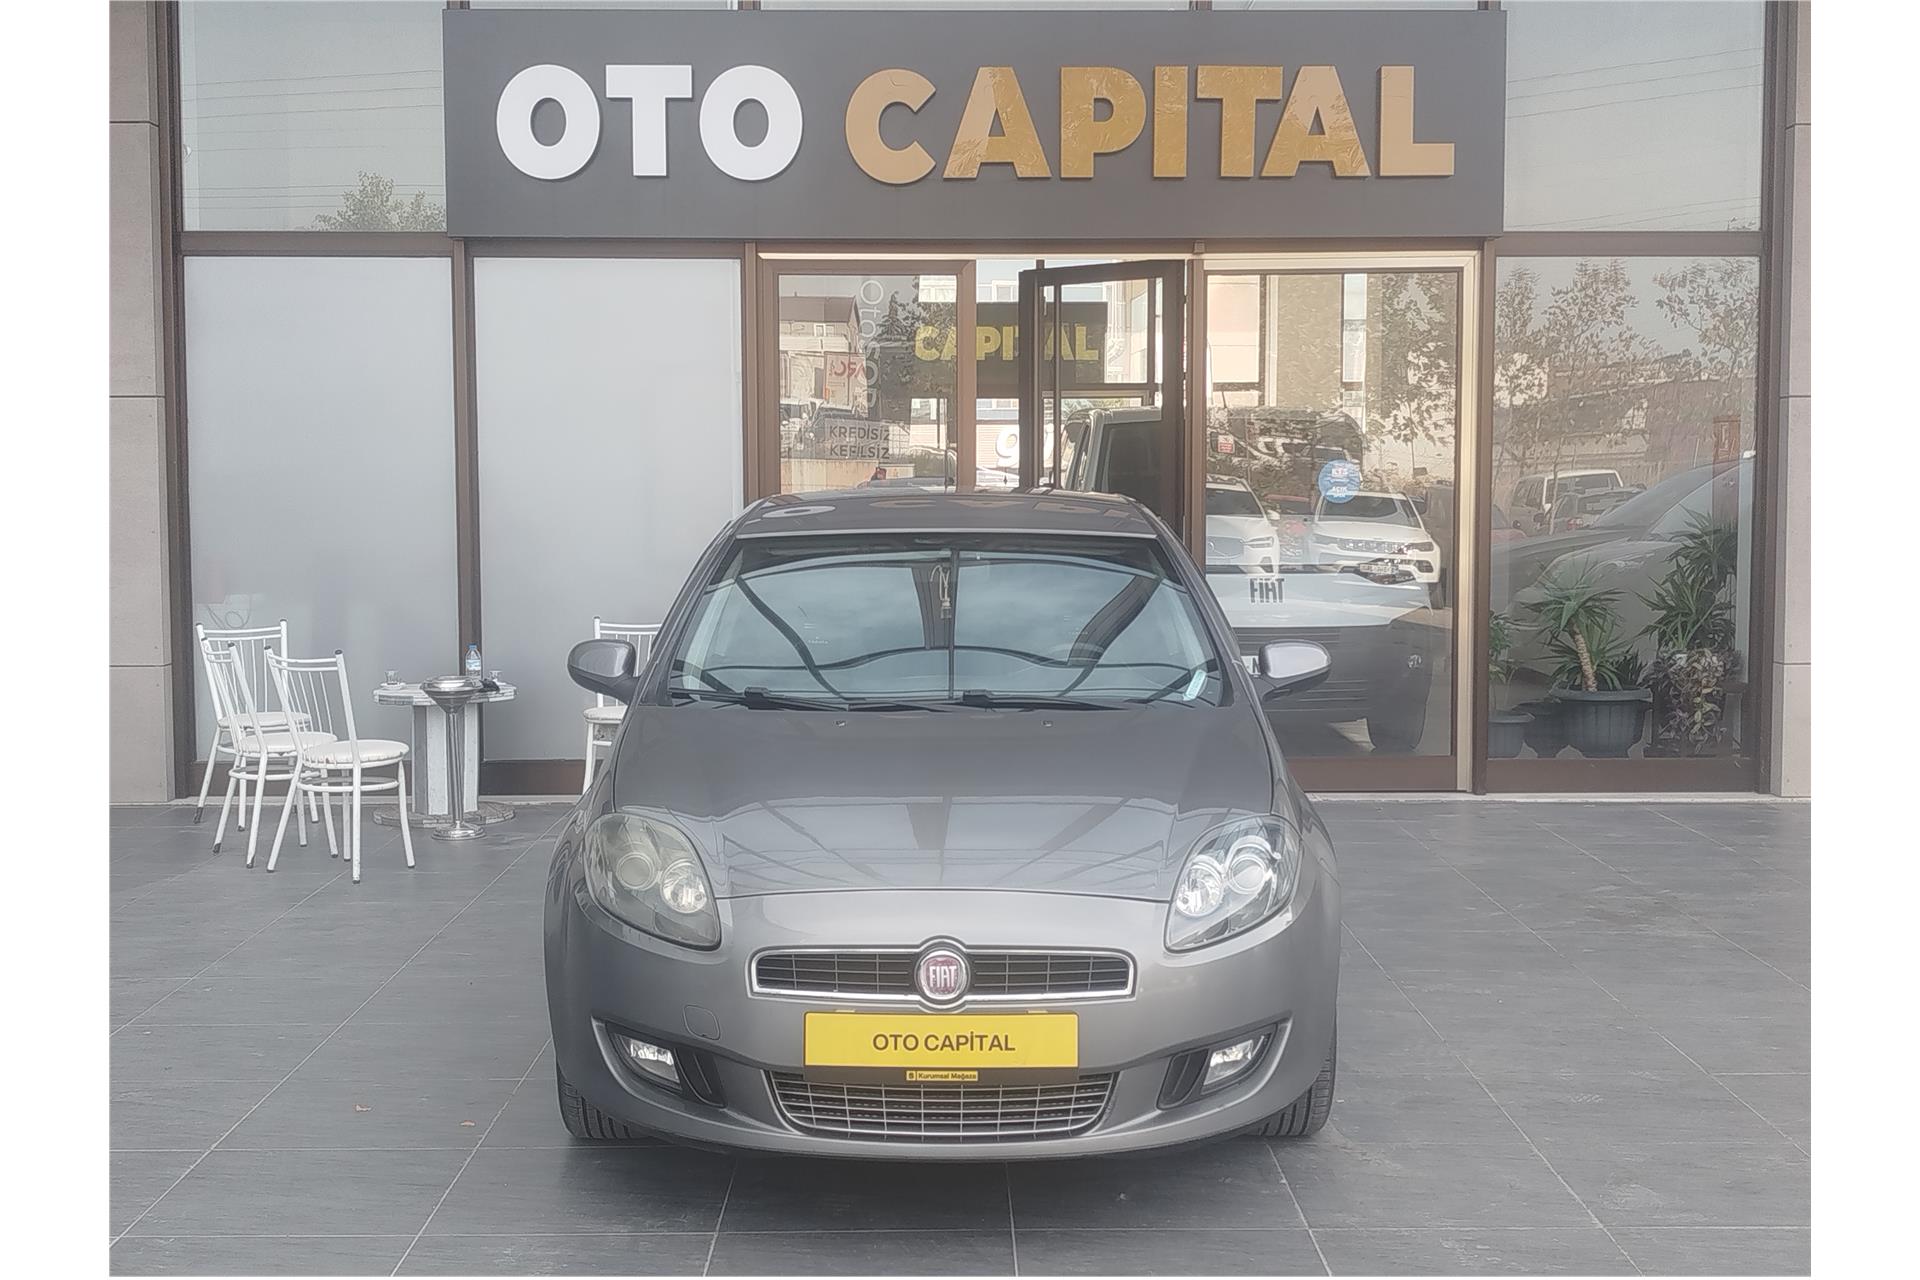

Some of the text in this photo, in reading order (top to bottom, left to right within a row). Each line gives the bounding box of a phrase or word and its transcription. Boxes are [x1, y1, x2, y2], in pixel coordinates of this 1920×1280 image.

[496, 64, 1455, 185] OTO CAPITAL
[914, 325, 1099, 361] CAPIAL
[1250, 578, 1284, 603] FIAT
[930, 965, 957, 988] FIAT
[873, 1031, 1016, 1051] OTO CAPİTAL
